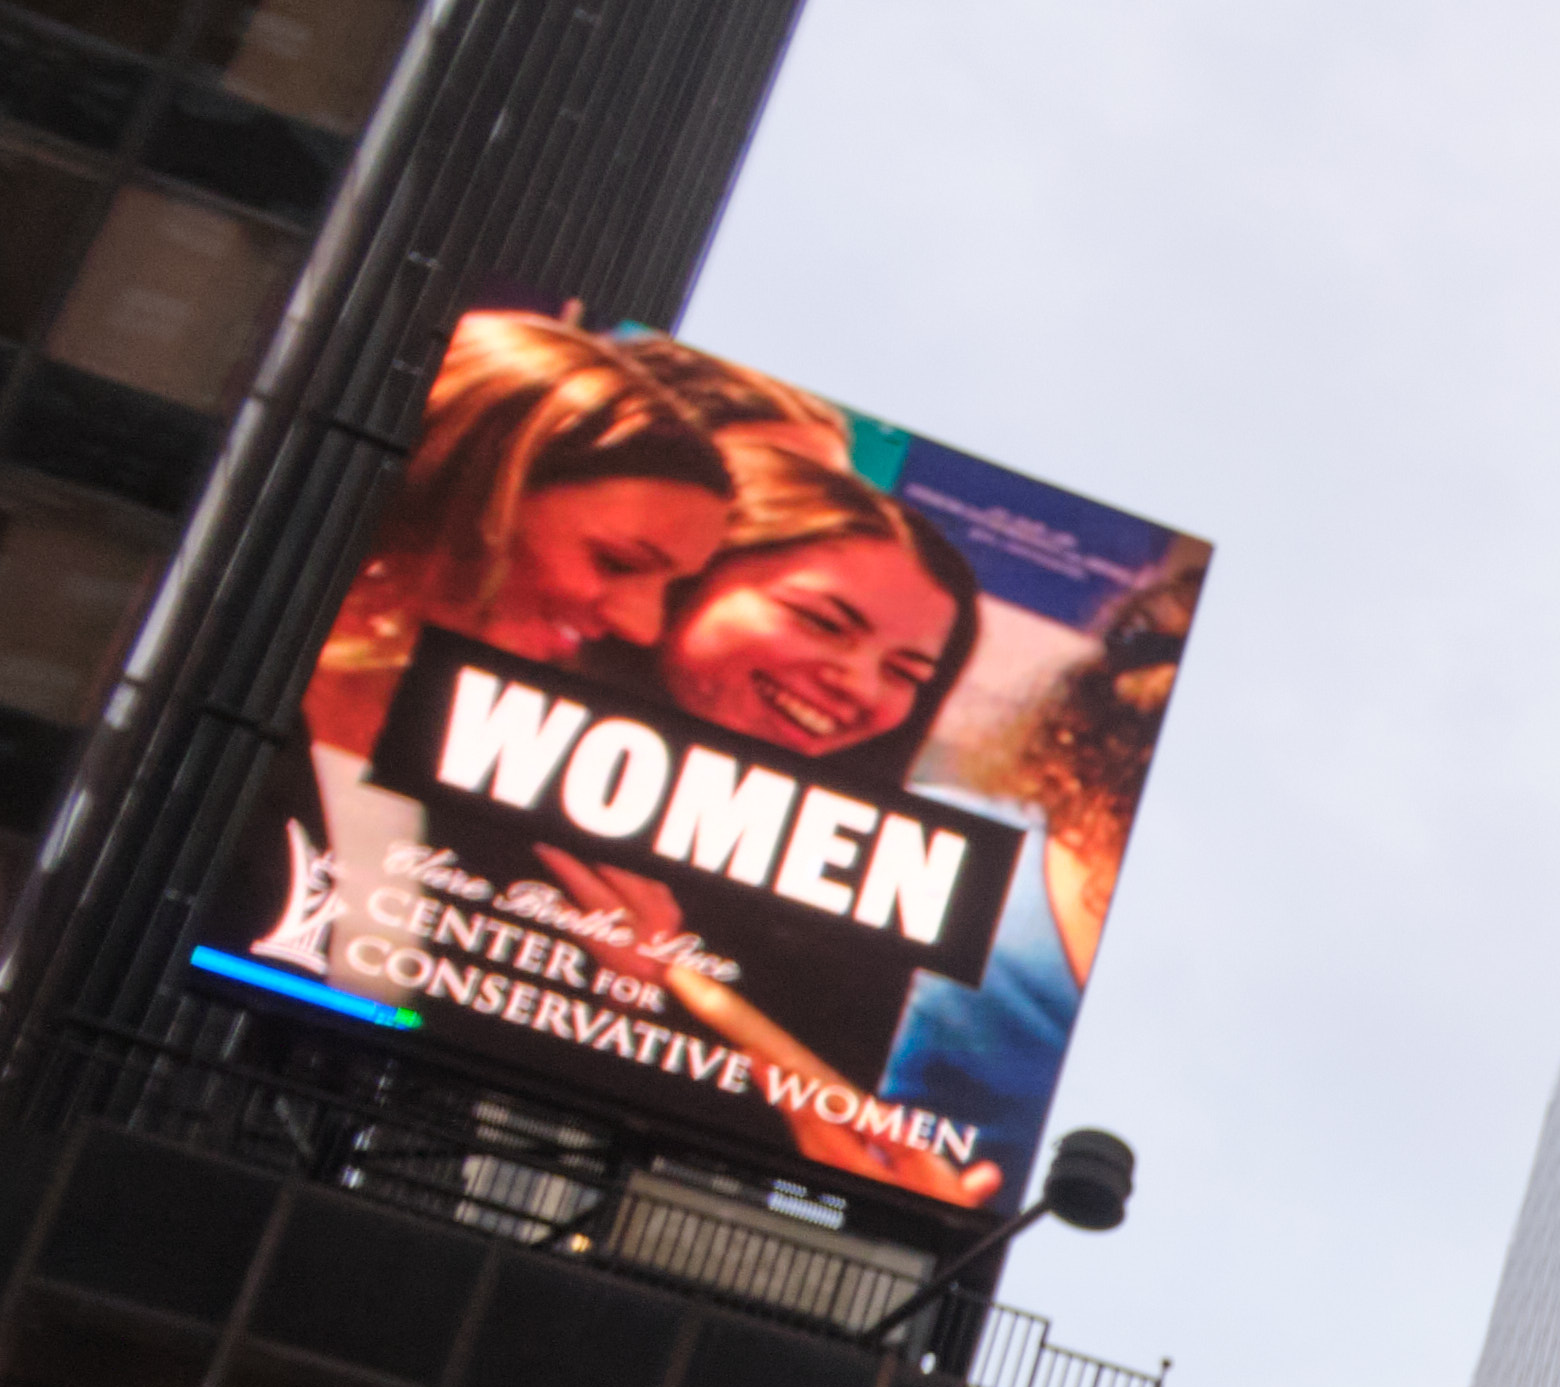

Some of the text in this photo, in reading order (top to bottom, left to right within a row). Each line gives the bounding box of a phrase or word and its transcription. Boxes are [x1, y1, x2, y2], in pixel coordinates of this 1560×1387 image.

[437, 665, 965, 944] WOMEN
[344, 934, 977, 1162] CONSERVATIVE WOMEN
[368, 886, 666, 1013] CENTER FOR
